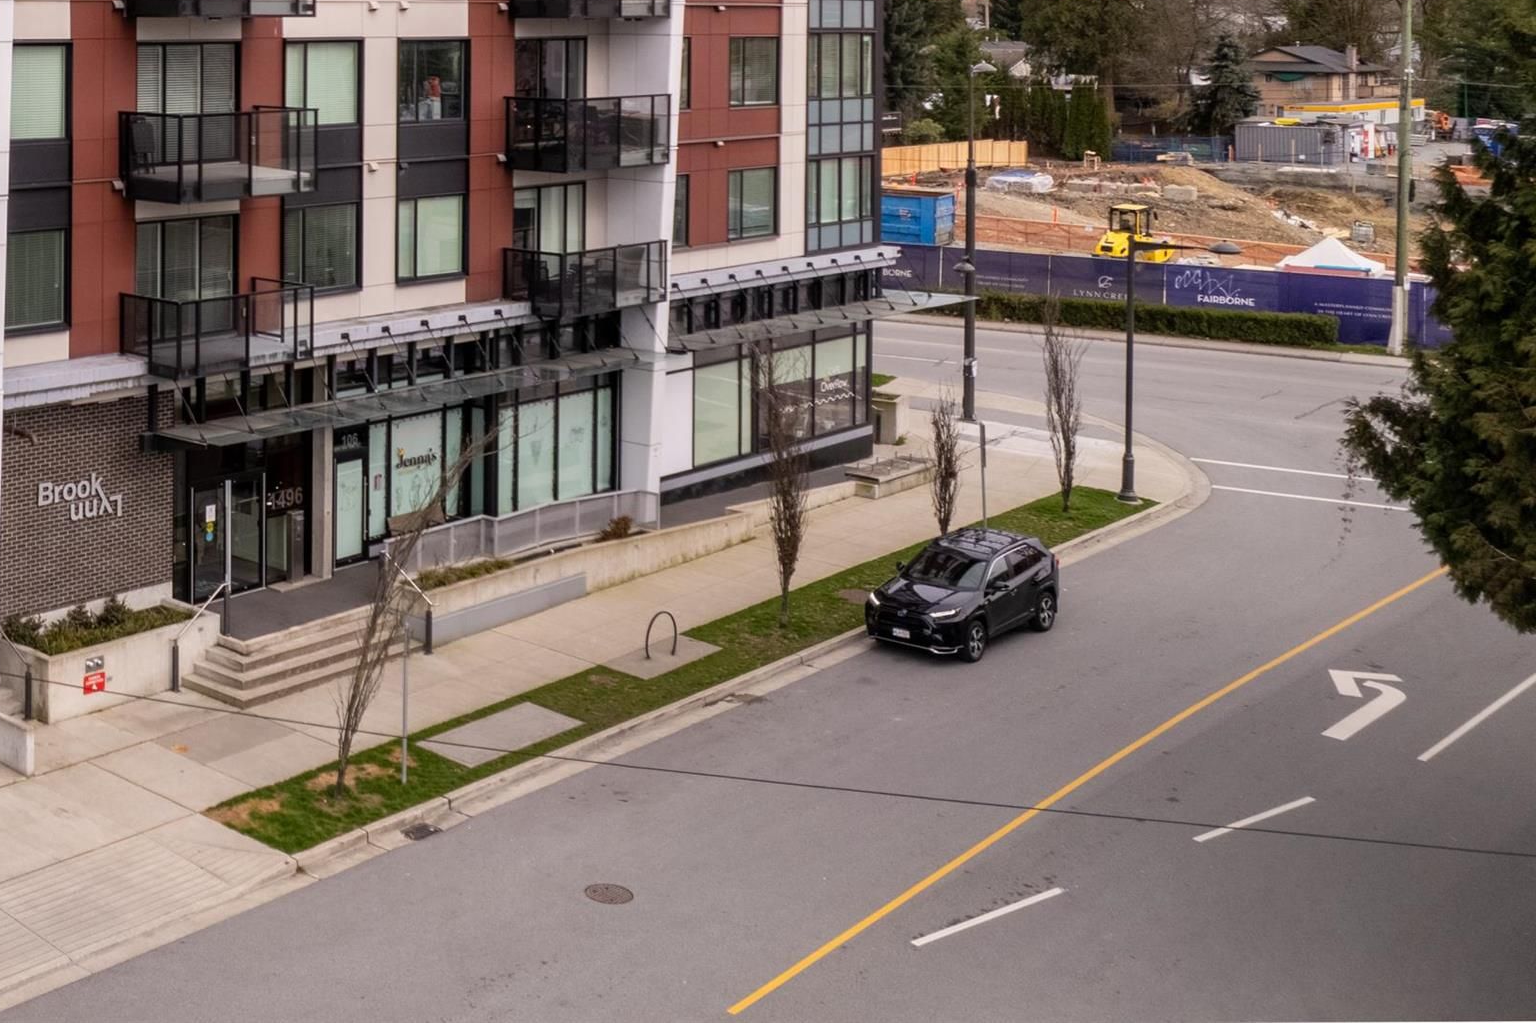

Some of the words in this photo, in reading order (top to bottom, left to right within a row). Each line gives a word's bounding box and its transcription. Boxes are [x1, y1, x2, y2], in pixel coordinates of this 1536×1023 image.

[882, 268, 912, 278] BORNE
[1103, 291, 1128, 300] CRE
[1197, 294, 1256, 307] FAIRBORNE
[342, 433, 359, 448] 106
[396, 448, 438, 469] Jenna's
[38, 473, 104, 506] Brook
[268, 487, 303, 509] 1496
